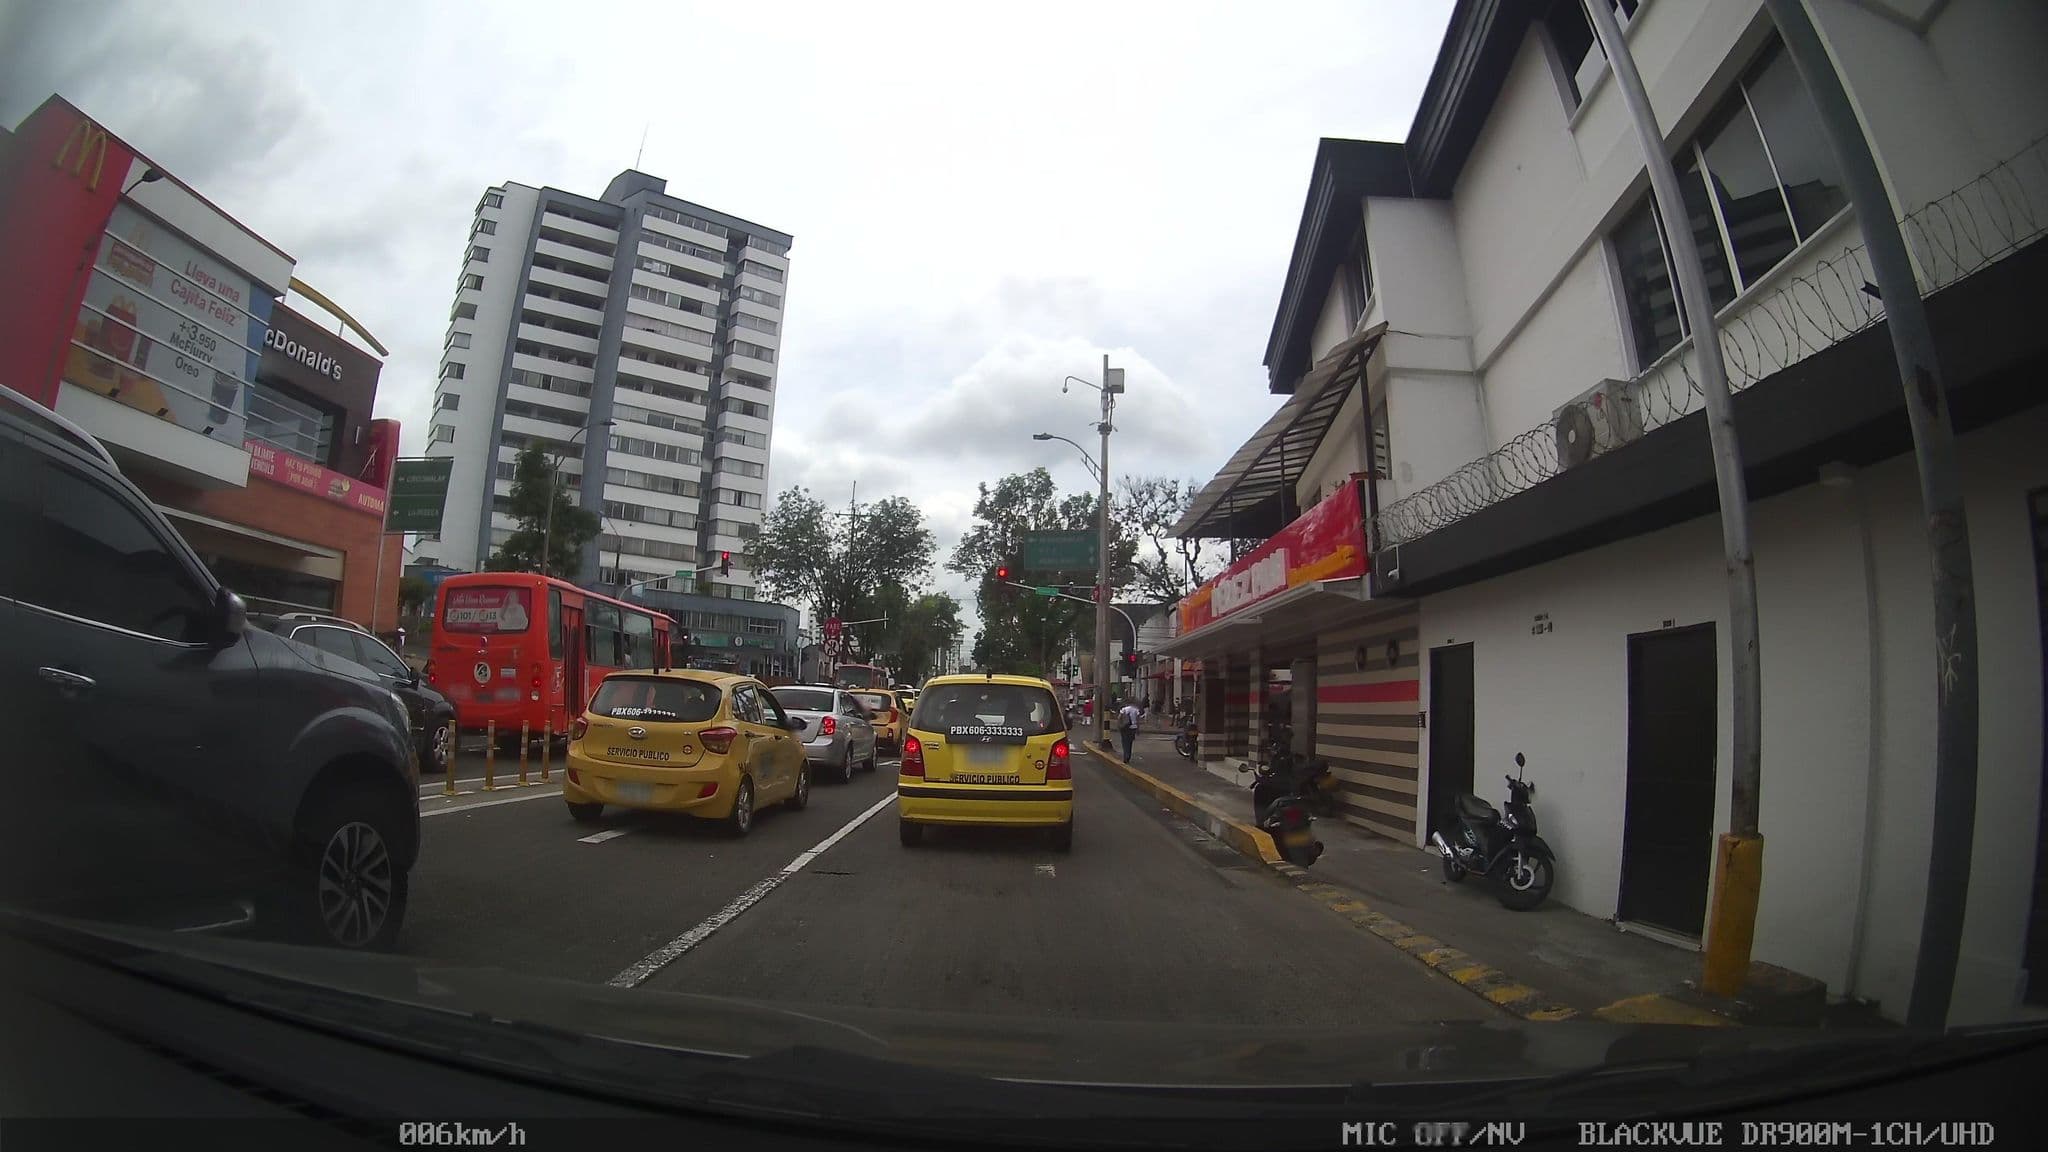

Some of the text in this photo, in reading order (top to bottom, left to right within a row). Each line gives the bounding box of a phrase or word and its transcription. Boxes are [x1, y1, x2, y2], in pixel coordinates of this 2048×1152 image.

[185, 260, 240, 303] Lleva una
[171, 278, 236, 327] Cajita Feliz
[175, 356, 199, 378] Oreo
[265, 328, 343, 380] cDonald's
[357, 493, 385, 513] AUTOMA
[607, 746, 637, 758] SERVICIO
